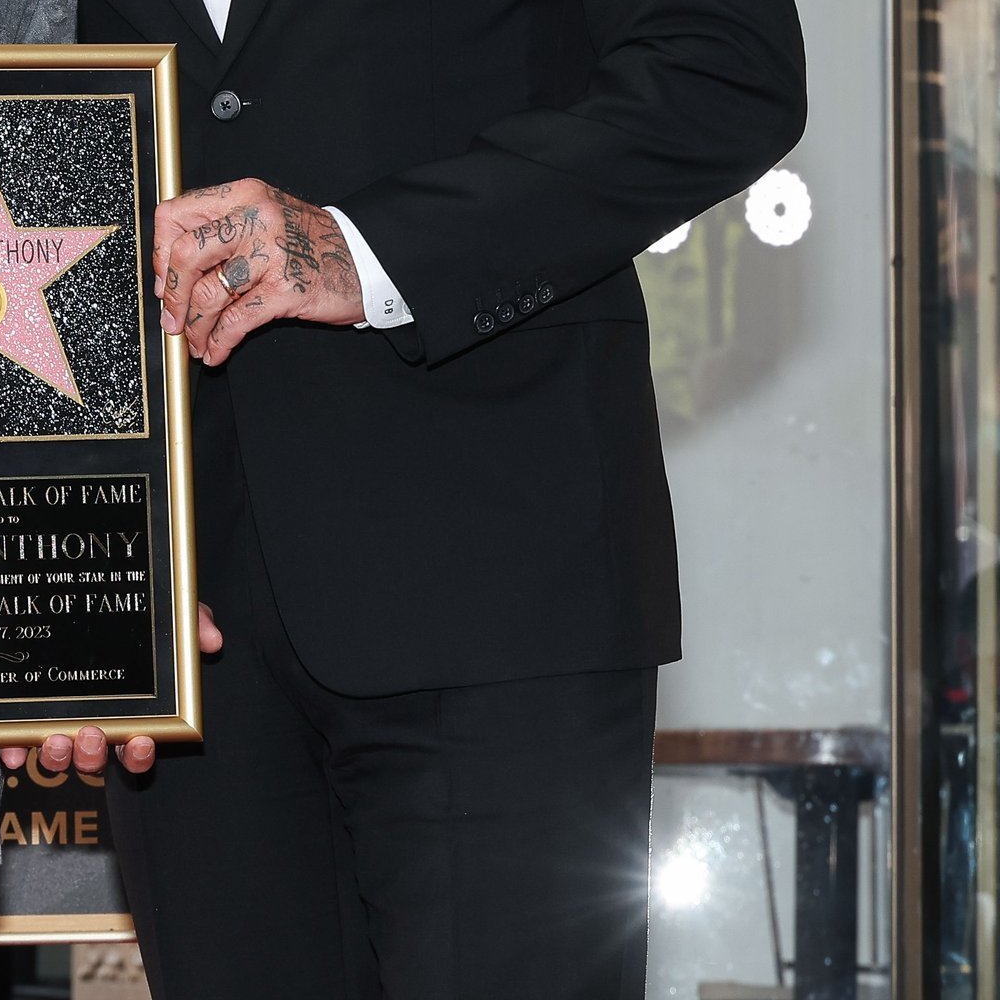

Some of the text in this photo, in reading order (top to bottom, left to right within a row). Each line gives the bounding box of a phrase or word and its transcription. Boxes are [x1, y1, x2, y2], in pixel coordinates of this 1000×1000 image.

[46, 486, 71, 505] OF
[82, 484, 141, 504] FAME
[28, 574, 41, 584] OF
[46, 573, 74, 583] YOUR
[79, 572, 105, 582] STAR
[111, 572, 121, 581] IN
[126, 571, 145, 581] THE
[50, 595, 76, 614] OF
[86, 593, 146, 612] FAME
[16, 626, 51, 638] 2023
